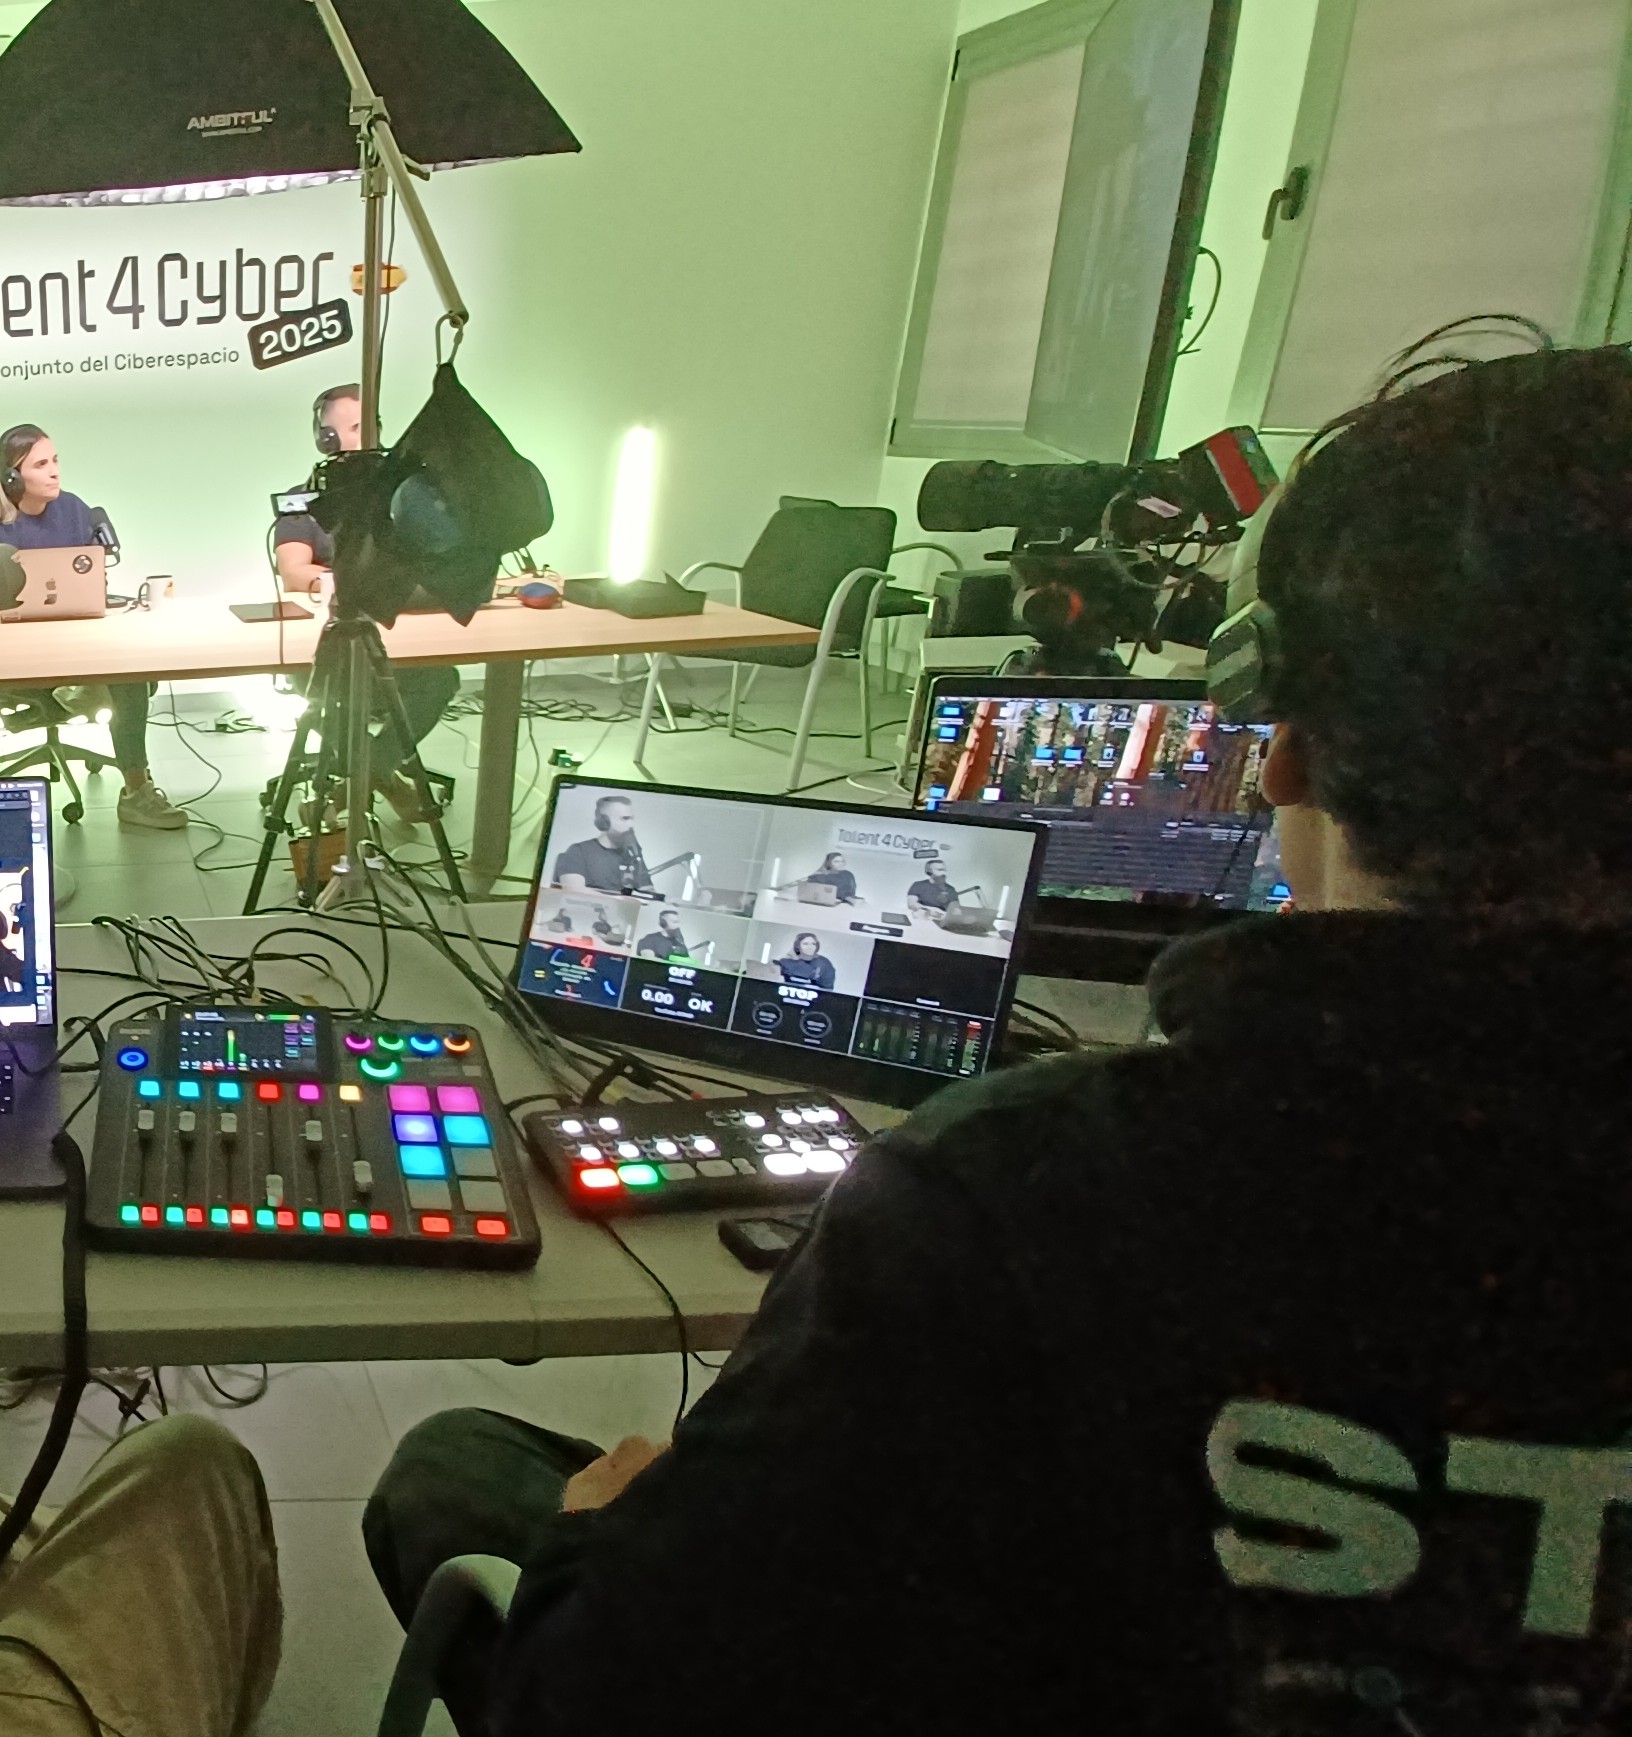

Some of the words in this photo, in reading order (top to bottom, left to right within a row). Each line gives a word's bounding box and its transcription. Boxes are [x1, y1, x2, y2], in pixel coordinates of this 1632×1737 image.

[258, 310, 343, 361] 2025
[80, 355, 109, 373] del
[114, 347, 240, 370] Ciberespacio
[641, 989, 675, 1005] 0.00
[688, 998, 714, 1013] OK
[778, 985, 819, 1001] STOP
